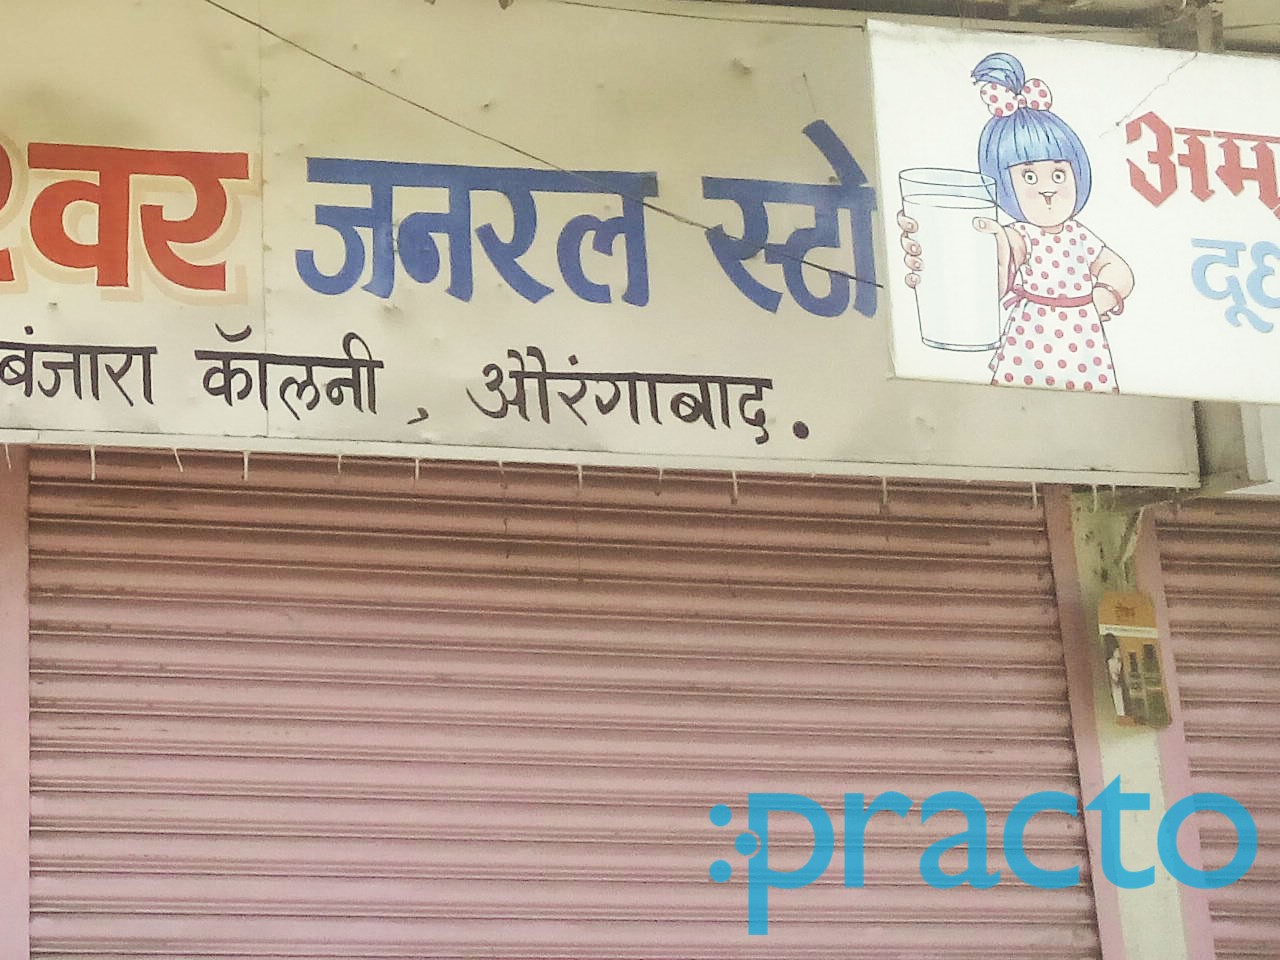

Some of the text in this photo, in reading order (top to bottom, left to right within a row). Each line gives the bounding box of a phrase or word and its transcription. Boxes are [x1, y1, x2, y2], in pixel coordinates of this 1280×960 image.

[1125, 111, 1280, 220] अम
[295, 156, 660, 307] जनरल
[466, 345, 810, 445] औरंगाबाद.
